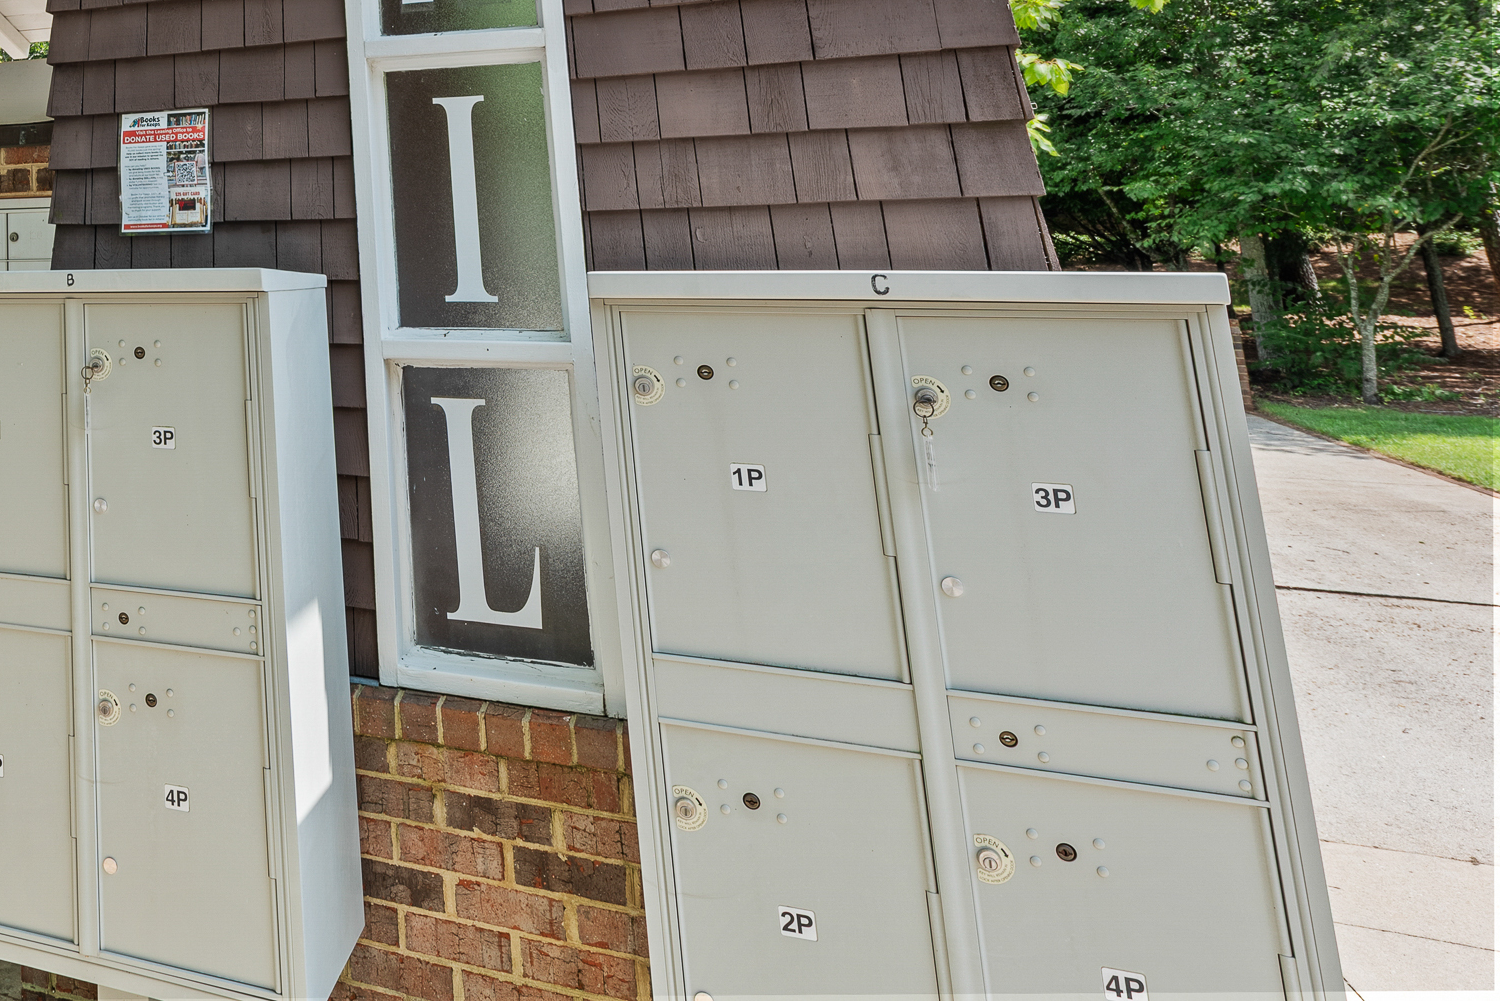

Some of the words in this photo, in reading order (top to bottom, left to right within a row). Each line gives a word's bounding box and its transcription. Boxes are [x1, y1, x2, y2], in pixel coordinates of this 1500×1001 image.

[124, 135, 154, 143] DONATE
[66, 274, 74, 286] B
[870, 274, 889, 296] C
[913, 377, 935, 386] OPEN
[153, 428, 174, 447] 3P
[732, 468, 764, 487] 1P
[1034, 486, 1072, 510] 3P
[100, 691, 114, 699] OPEN
[166, 789, 188, 808] 4P
[674, 788, 694, 798] OPEN
[976, 837, 999, 848] OPEN
[780, 912, 814, 934] 2P
[1105, 975, 1145, 1000] 4P
